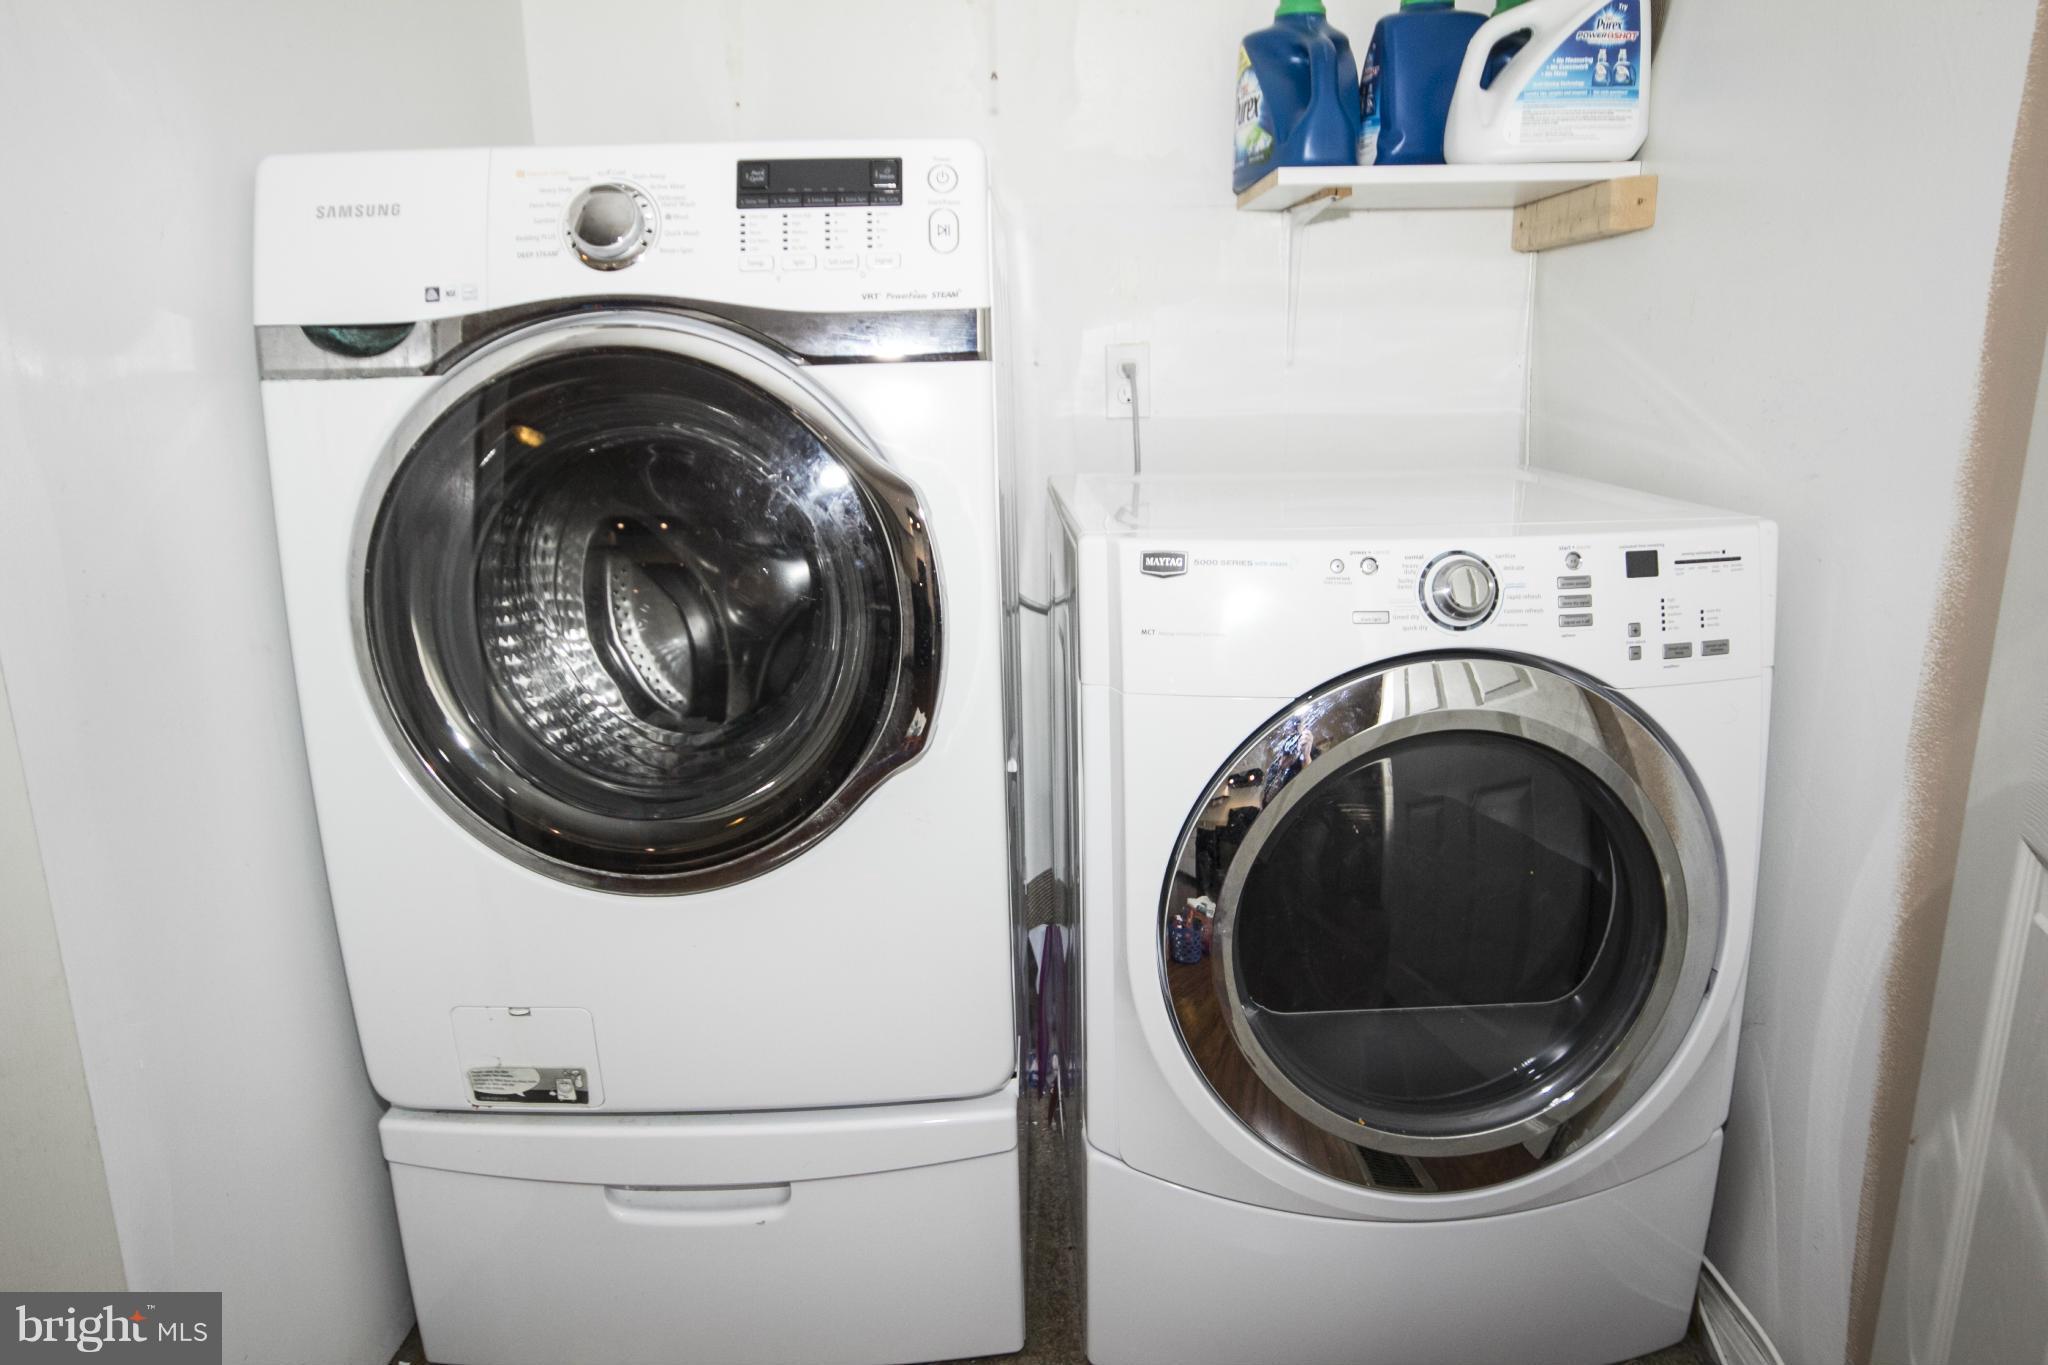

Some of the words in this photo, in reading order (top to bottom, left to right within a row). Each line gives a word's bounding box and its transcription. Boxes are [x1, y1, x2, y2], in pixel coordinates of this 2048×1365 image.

[1619, 2, 1628, 11] Try
[1596, 18, 1622, 30] Purex
[316, 203, 401, 219] SAMSUNG
[1145, 556, 1183, 567] MAYTAG
[1220, 559, 1253, 567] SERIES
